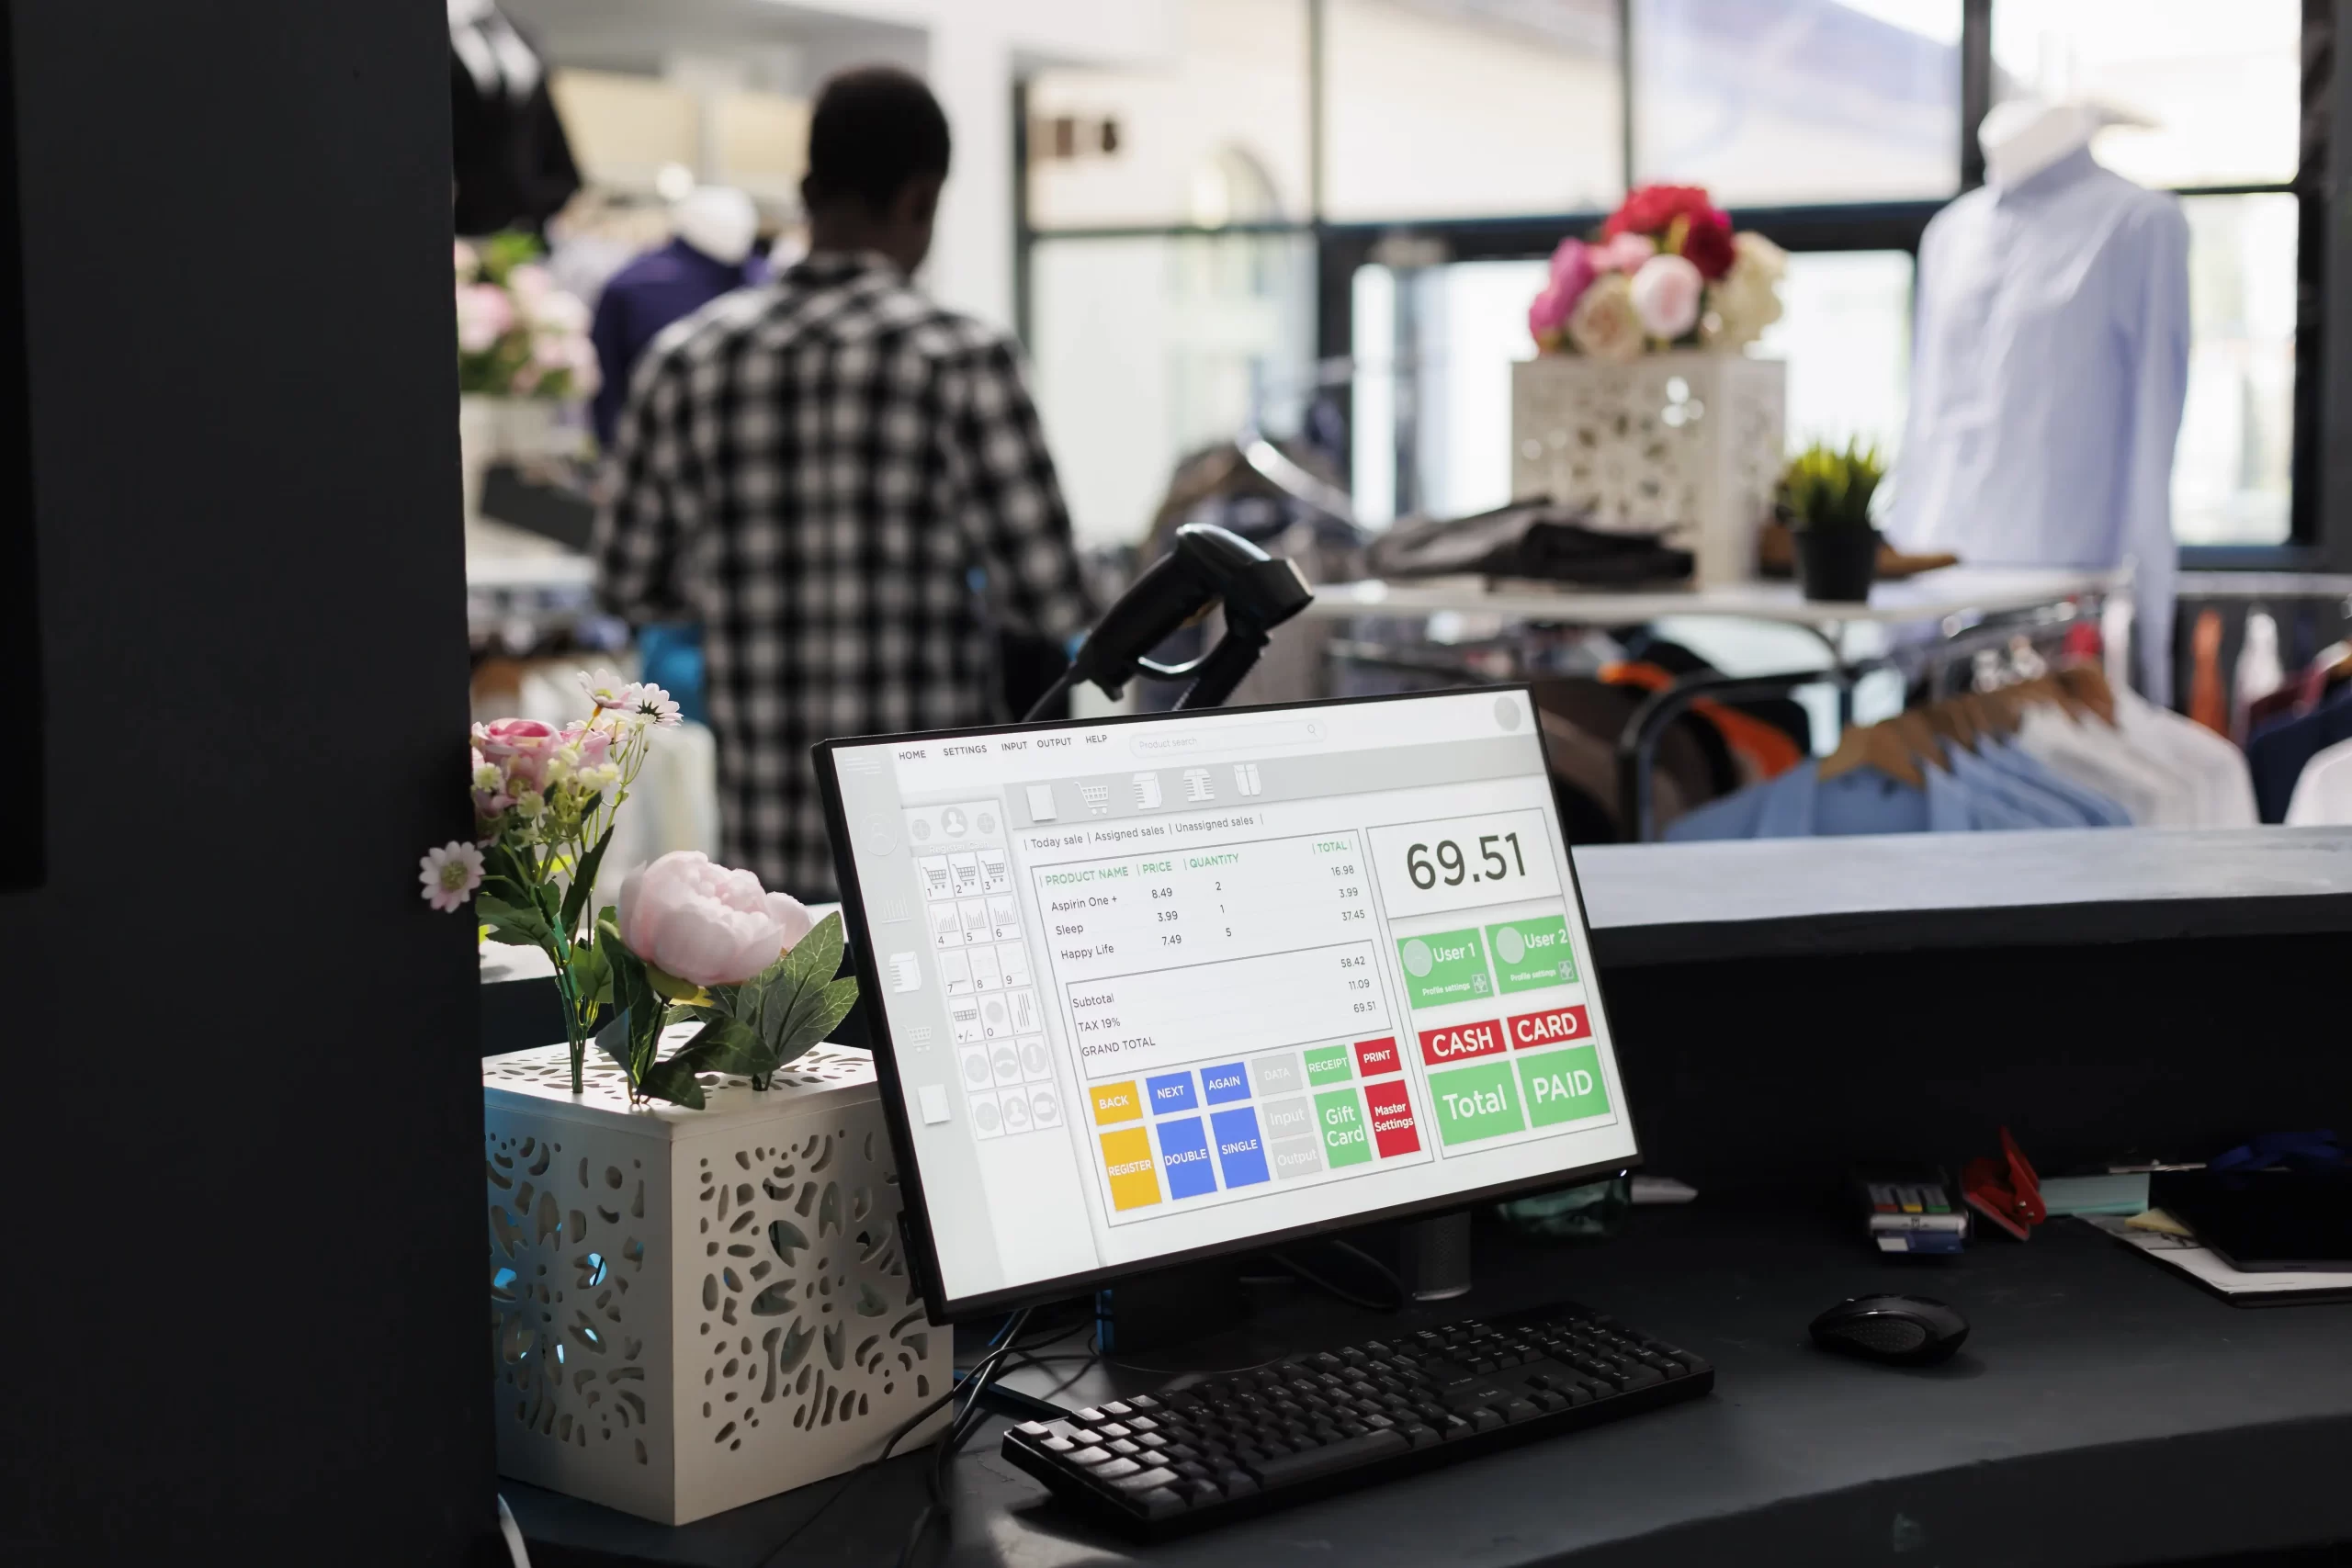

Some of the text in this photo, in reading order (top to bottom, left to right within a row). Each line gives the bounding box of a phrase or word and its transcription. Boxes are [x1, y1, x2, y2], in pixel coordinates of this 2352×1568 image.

[1001, 741, 1028, 750] INPUT
[1036, 738, 1072, 749] OUTPUT
[1085, 734, 1108, 744] HELP
[1139, 737, 1197, 750] Product search
[899, 750, 926, 761] HOME
[944, 745, 987, 757] SETTINGS
[1175, 816, 1254, 832] Unassigned sales
[1094, 825, 1165, 841] Assigned sales
[930, 840, 989, 853] Register Cash
[1031, 834, 1083, 849] Today sale
[1317, 841, 1348, 852] TOTAL
[1190, 853, 1239, 868] QUANTITY
[1407, 831, 1526, 890] 69.51
[1142, 862, 1172, 874] PRICE
[1331, 864, 1354, 876] 16.98
[1045, 866, 1129, 886] PRODUCT NAME
[927, 887, 933, 897] 1
[956, 885, 963, 894] 2
[985, 881, 991, 891] 3
[1151, 887, 1172, 899] 8.49
[1216, 881, 1222, 891] 2
[1339, 886, 1359, 898] 3.99
[1051, 898, 1086, 911] Aspirin
[1088, 896, 1109, 907] One
[1220, 905, 1225, 914] 1
[1157, 910, 1179, 922] 3.99
[1341, 909, 1365, 921] 37.45
[995, 928, 1002, 938] 6
[1056, 923, 1084, 935] Sleep
[1226, 927, 1232, 937] 5
[937, 936, 944, 945] 4
[967, 932, 973, 942] 5
[1162, 934, 1182, 946] 7.49
[1524, 929, 1568, 949] User 2
[1061, 943, 1114, 960] Happy Life
[1432, 942, 1476, 963] User 1
[1340, 956, 1365, 968] 58.42
[1005, 975, 1012, 985] 9
[1510, 968, 1556, 982] Profile settings
[947, 984, 954, 994] 7
[977, 979, 984, 989] 8
[1349, 979, 1370, 990] 11.09
[1422, 982, 1471, 997] Profile settings
[1073, 993, 1114, 1009] Subtotal
[1353, 1001, 1376, 1013] 69.51
[1078, 1018, 1121, 1032] TAX 19%
[1517, 1012, 1577, 1043] CARD
[1081, 1036, 1156, 1057] GRAND TOTAL
[1432, 1026, 1494, 1057] CASH
[1363, 1049, 1391, 1064] PRINT
[1308, 1057, 1348, 1073] RECEIPT
[1264, 1067, 1291, 1081] DATA
[1208, 1076, 1240, 1091] AGAIN
[1532, 1069, 1593, 1104] PAID
[1157, 1085, 1184, 1100] NEXT
[1099, 1095, 1129, 1110] BACK
[1442, 1084, 1508, 1120] Total
[1326, 1105, 1356, 1125] Gift
[1374, 1102, 1407, 1117] Master
[1270, 1108, 1305, 1126] Input
[1374, 1117, 1414, 1133] Settings
[1327, 1125, 1365, 1147] Card
[1221, 1138, 1258, 1156] SINGLE
[1165, 1149, 1208, 1166] DOUBLE
[1277, 1149, 1317, 1167] Output
[1108, 1159, 1152, 1177] REGISTER
